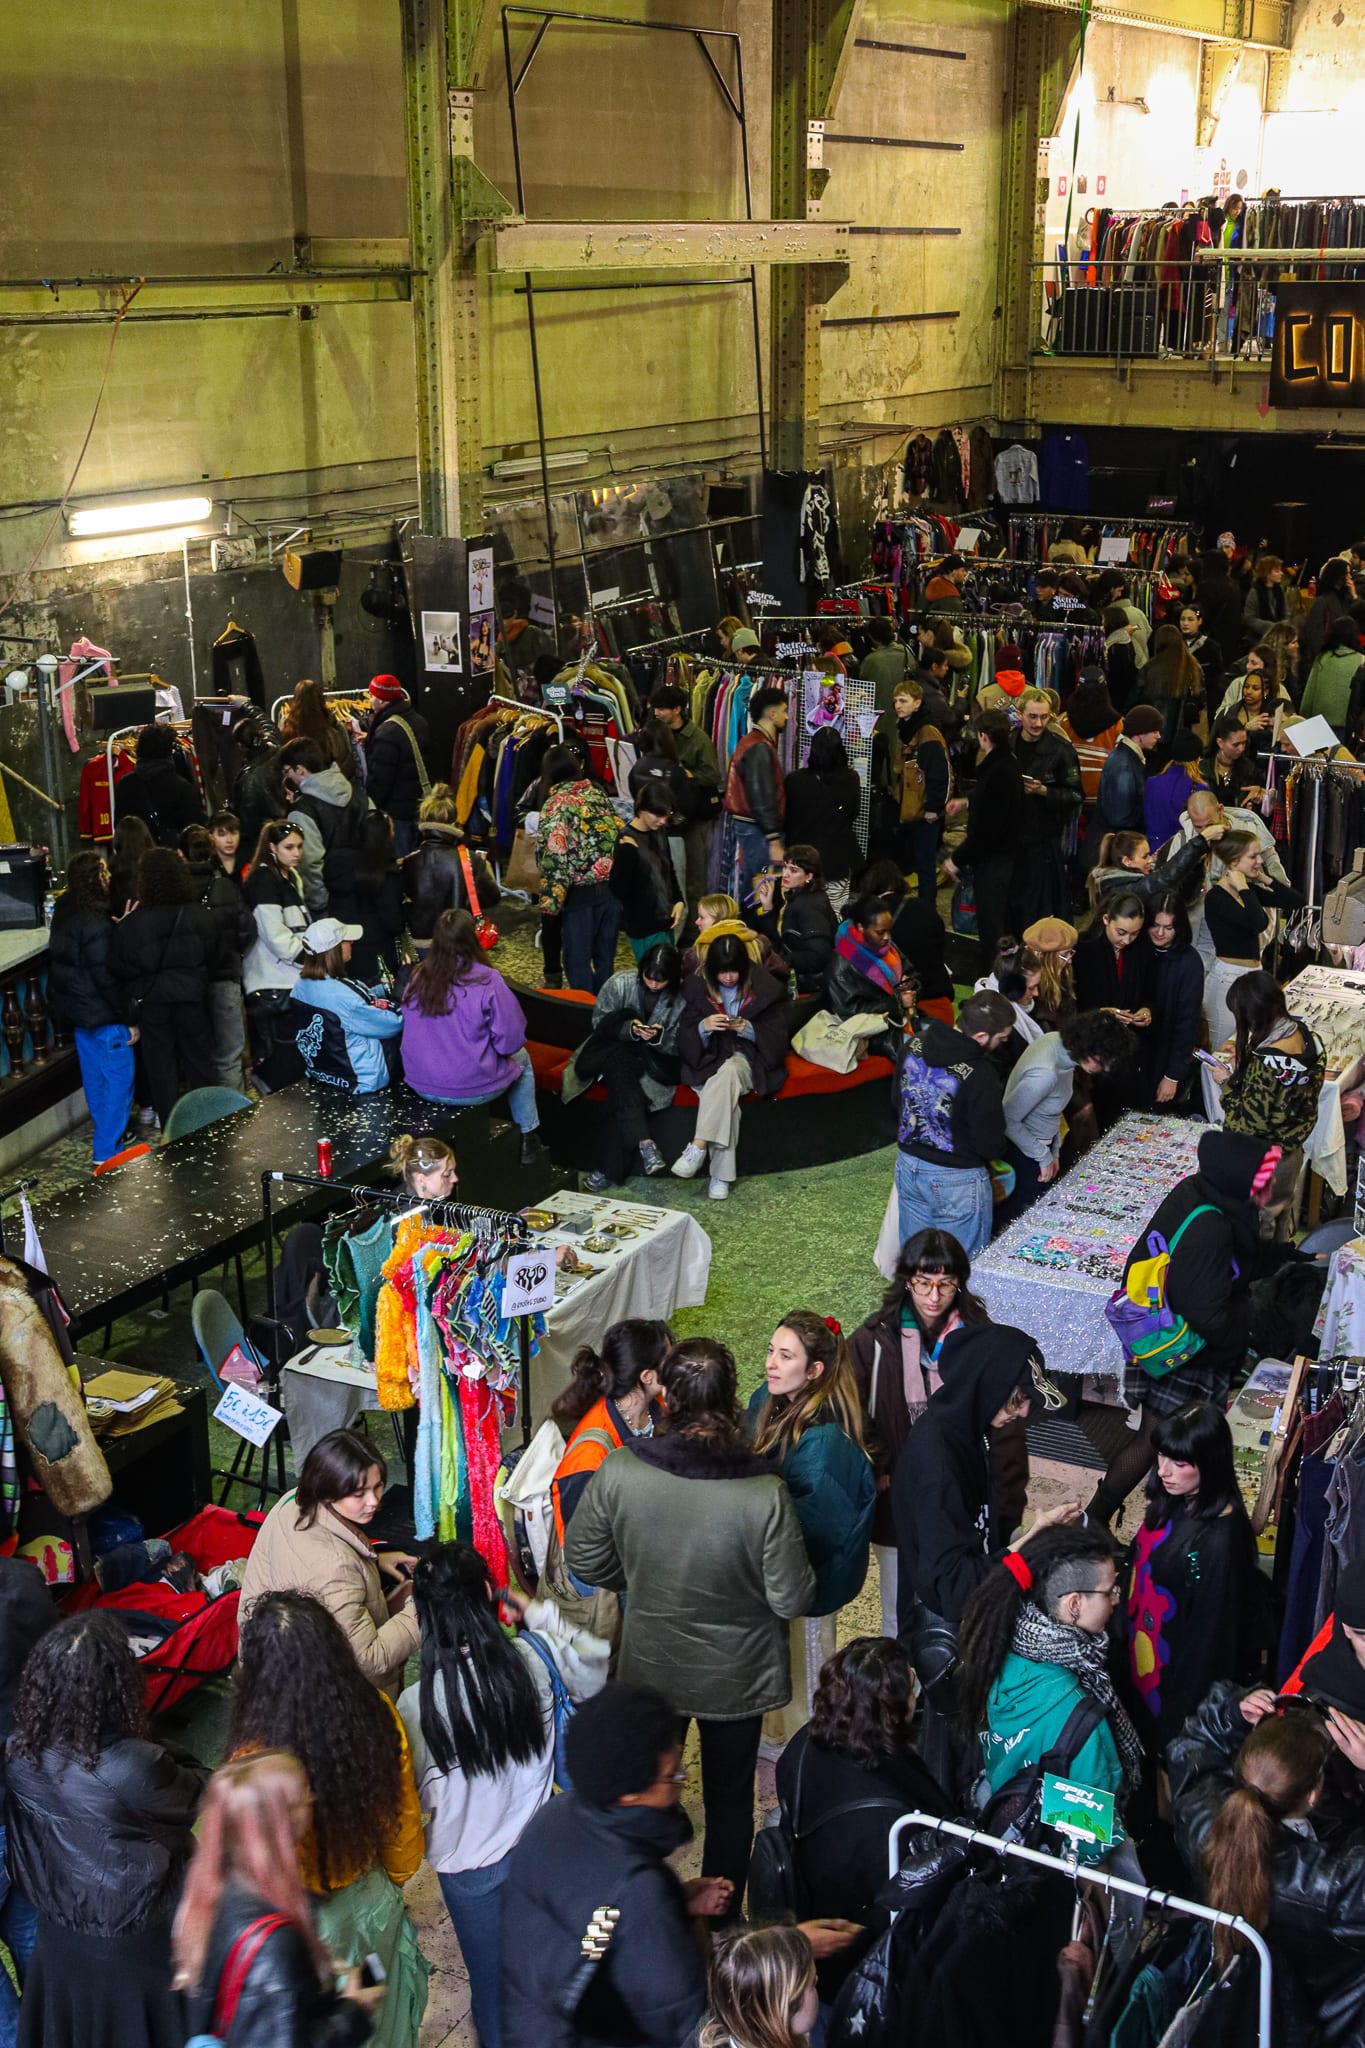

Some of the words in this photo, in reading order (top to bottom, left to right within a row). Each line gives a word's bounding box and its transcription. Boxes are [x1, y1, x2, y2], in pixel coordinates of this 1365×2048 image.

[748, 590, 775, 600] Retro
[1053, 595, 1079, 603] Retro
[1052, 601, 1087, 609] Satanas
[775, 641, 807, 651] Retro
[775, 647, 818, 660] Satanas
[100, 812, 110, 825] 10
[1052, 1781, 1095, 1800] SPIN
[1062, 1792, 1105, 1812] SPIN
